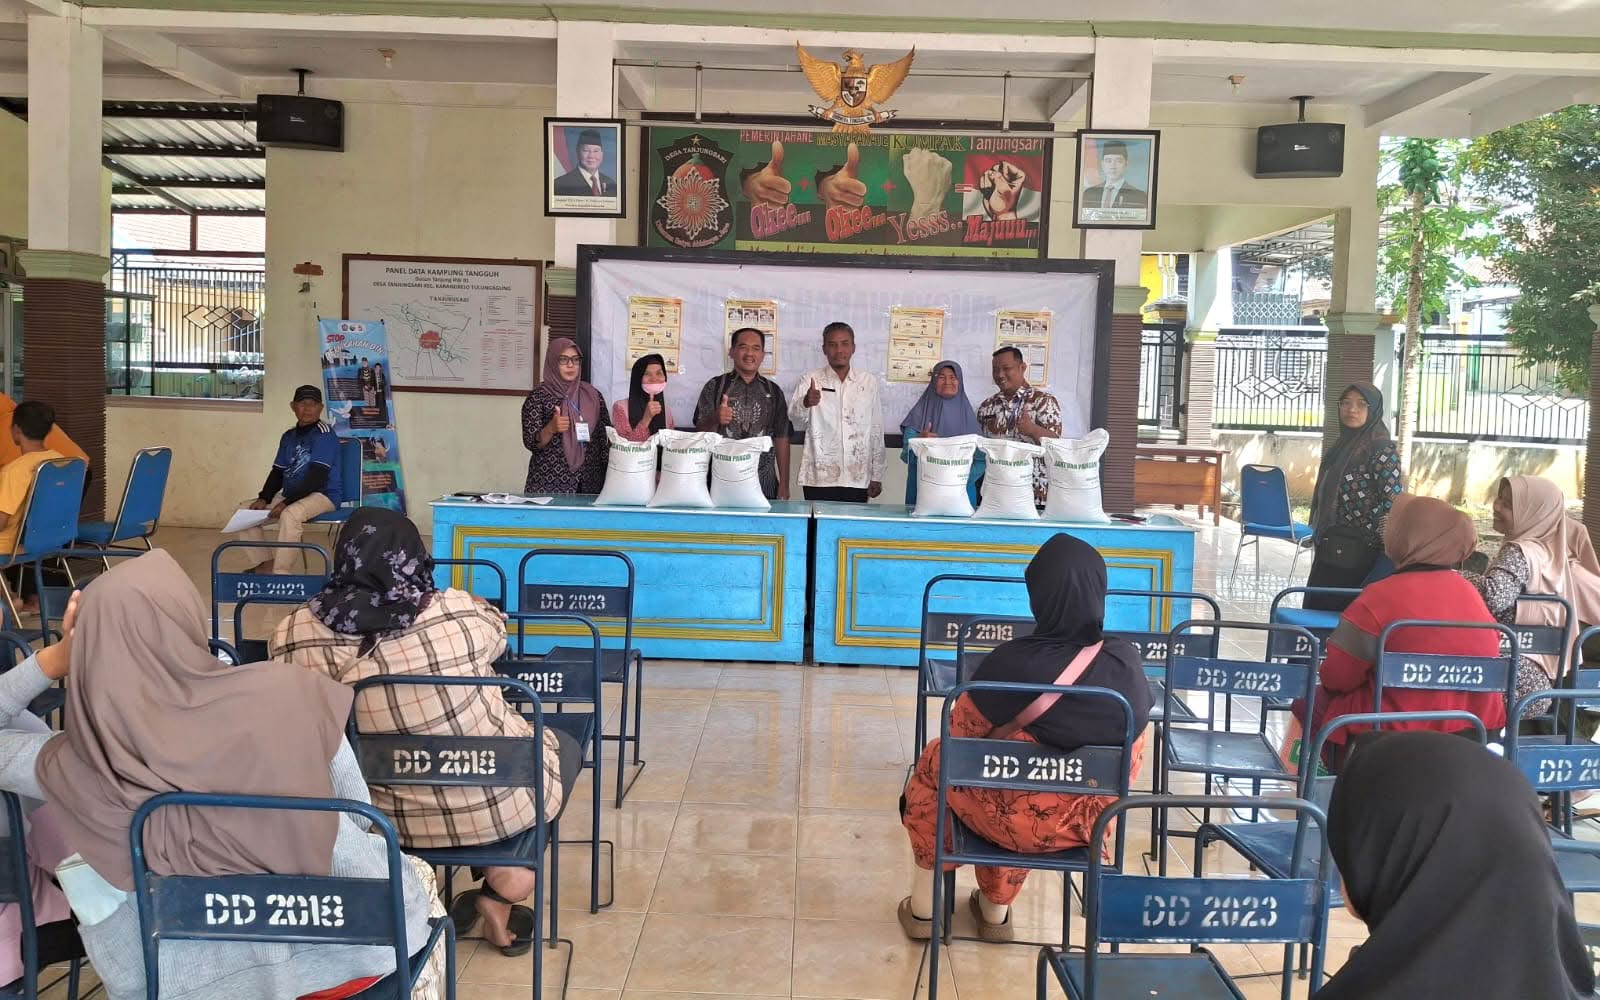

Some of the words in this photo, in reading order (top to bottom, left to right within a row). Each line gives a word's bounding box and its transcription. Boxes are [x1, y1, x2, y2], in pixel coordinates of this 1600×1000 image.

[664, 149, 682, 161] DESA
[385, 267, 407, 275] PANEL
[427, 269, 464, 277] KAMPUNG
[465, 270, 500, 278] TANGGUH
[326, 333, 346, 344] STOP
[237, 582, 261, 598] DD
[266, 583, 305, 596] 2023
[540, 593, 564, 610] DD
[568, 594, 606, 610] 2023
[975, 623, 1014, 641] 2018
[1195, 667, 1228, 688] DD
[1233, 670, 1282, 693] 2023
[1402, 663, 1432, 684] DD
[1436, 664, 1484, 685] 2023
[393, 749, 432, 774] DD
[438, 750, 497, 776] 2018
[983, 754, 1020, 779] DD
[1026, 756, 1083, 782] 2018
[1538, 759, 1573, 784] DD
[205, 893, 257, 925] DD
[266, 894, 345, 927] 2018
[1142, 894, 1191, 927] DD
[1201, 895, 1278, 927] 2023
